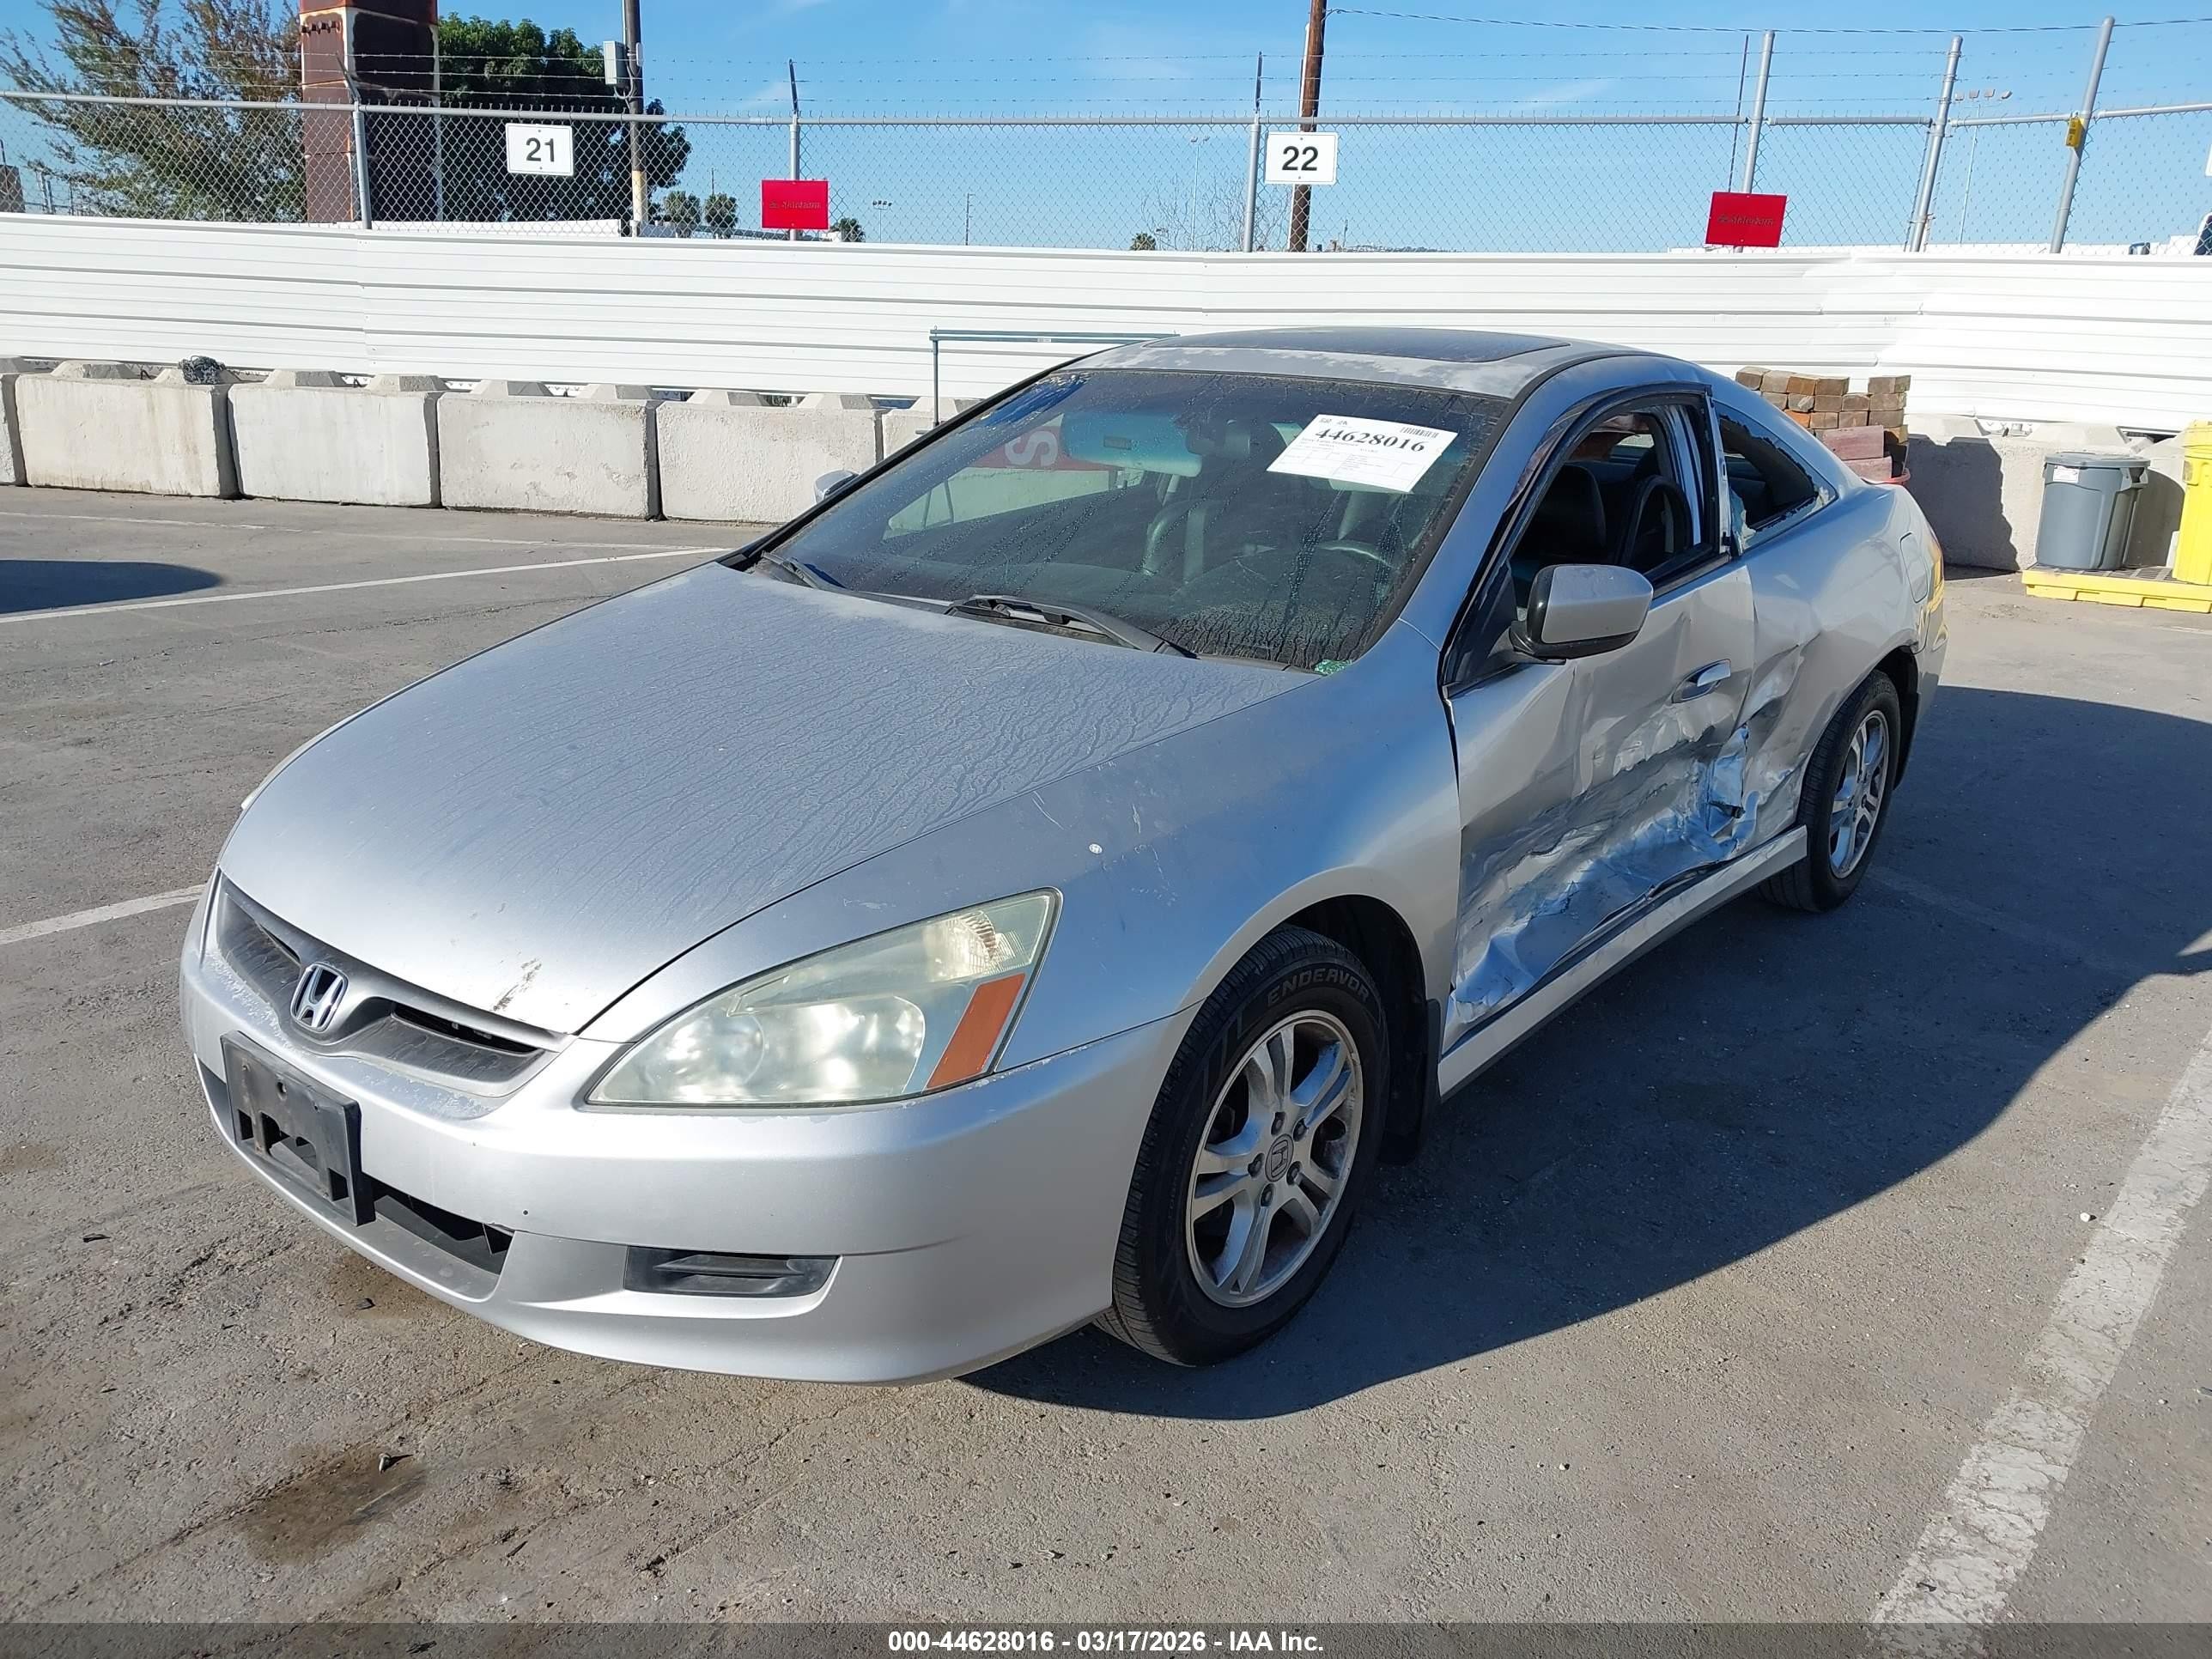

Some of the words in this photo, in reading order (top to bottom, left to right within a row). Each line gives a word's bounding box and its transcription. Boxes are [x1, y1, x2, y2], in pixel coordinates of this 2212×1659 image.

[526, 137, 555, 162] 21
[1281, 145, 1319, 171] 22
[1314, 428, 1429, 453] 44628016
[1267, 968, 1371, 1006] ENDEAVOR
